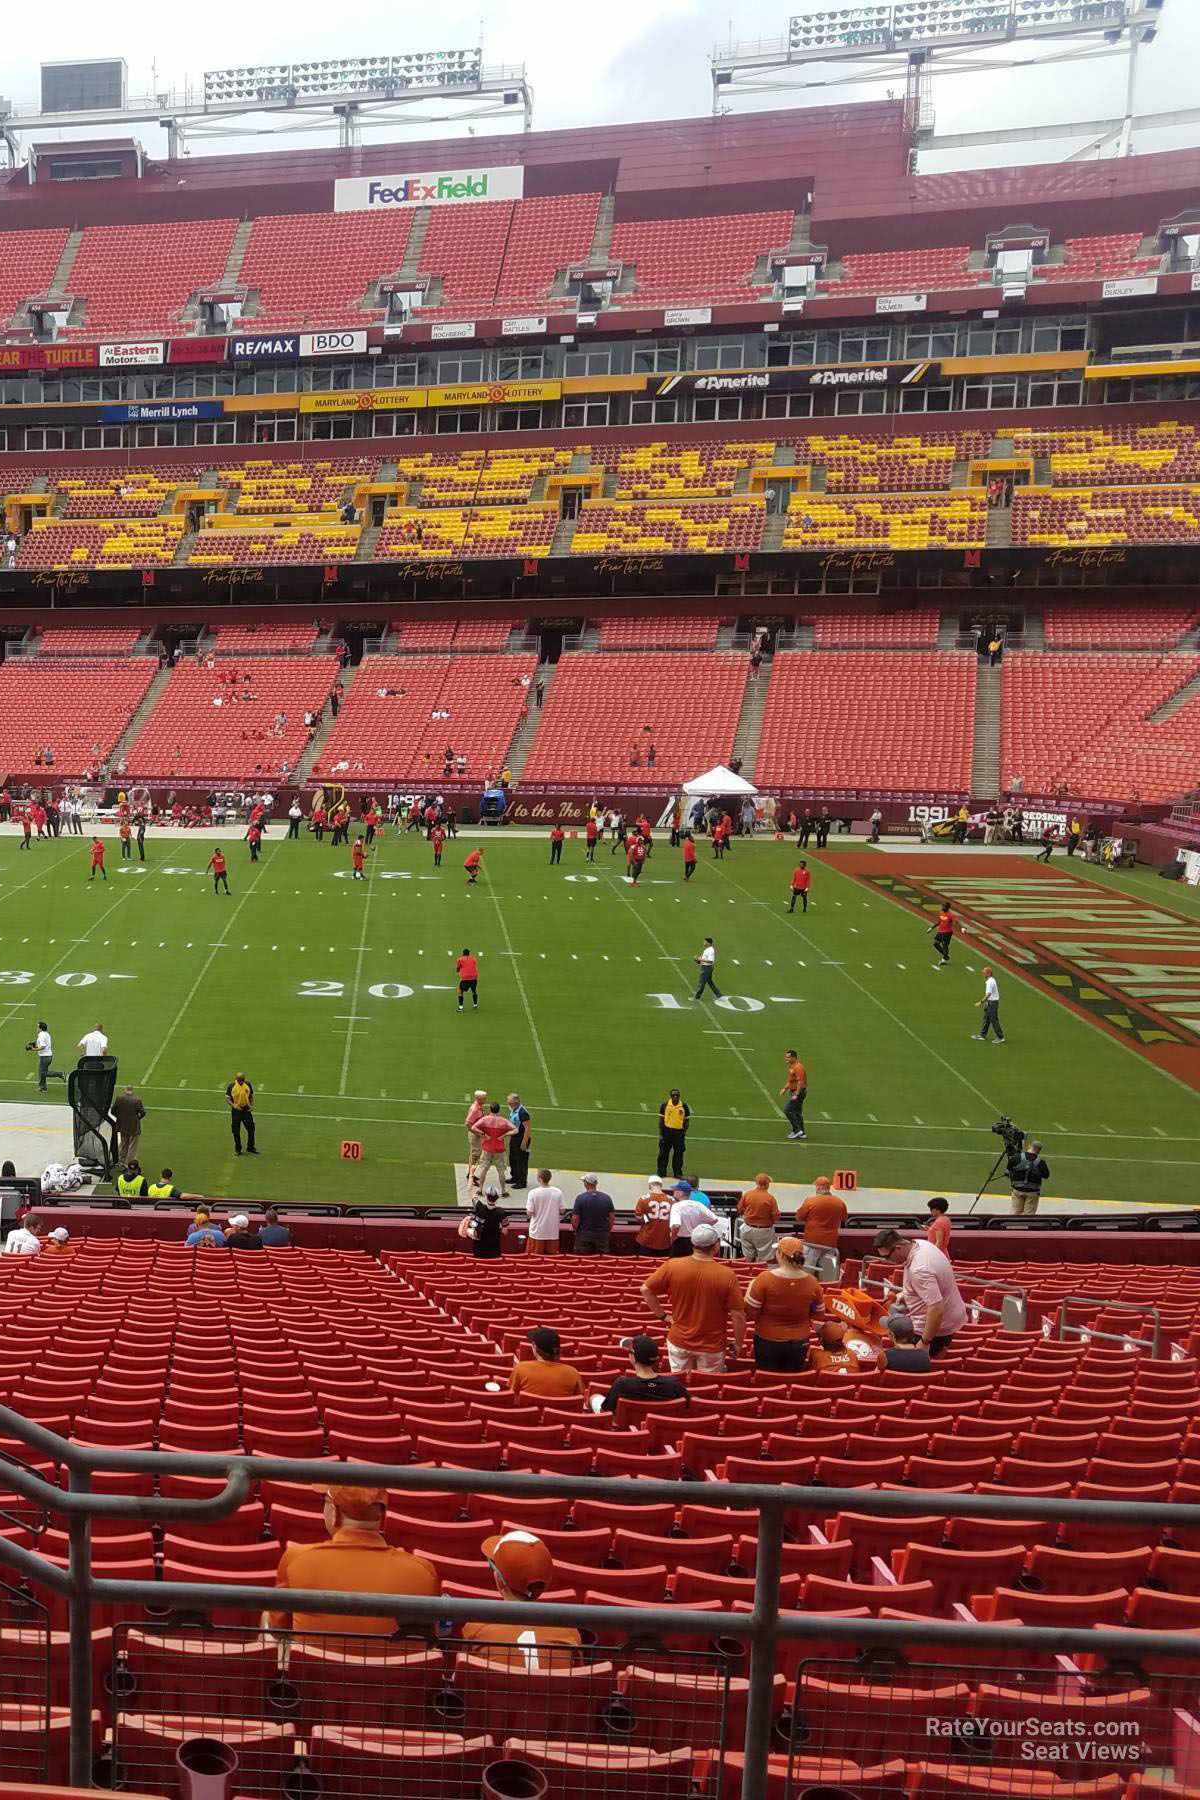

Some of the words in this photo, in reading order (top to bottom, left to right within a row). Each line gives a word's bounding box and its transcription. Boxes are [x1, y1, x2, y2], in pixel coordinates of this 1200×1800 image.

[368, 174, 488, 204] FedExField
[1104, 288, 1133, 296] DUDLEY
[235, 340, 294, 355] RE/MAX
[316, 333, 354, 349] BDO
[113, 345, 159, 356] Eastern
[105, 356, 145, 364] Motors...
[706, 373, 770, 389] Ameritel
[821, 368, 888, 385] Ameritel
[314, 398, 357, 408] MARYLAND
[375, 396, 409, 405] LOTTERY
[444, 391, 487, 402] MARYLAND
[507, 388, 543, 398] LOTTERY
[140, 407, 170, 418] Merrill
[171, 406, 198, 418] Lynch
[514, 803, 530, 818] to
[531, 802, 556, 818] the
[908, 806, 949, 823] 1991
[1021, 811, 1067, 823] REDSKINS
[296, 980, 415, 998] 20
[645, 993, 766, 1012] 10
[343, 1143, 360, 1159] 20
[837, 1172, 855, 1189] 10
[648, 1201, 670, 1220] 32
[830, 1298, 856, 1320] TEXAS
[830, 1354, 850, 1364] TEXAS
[516, 1630, 540, 1669] 1
